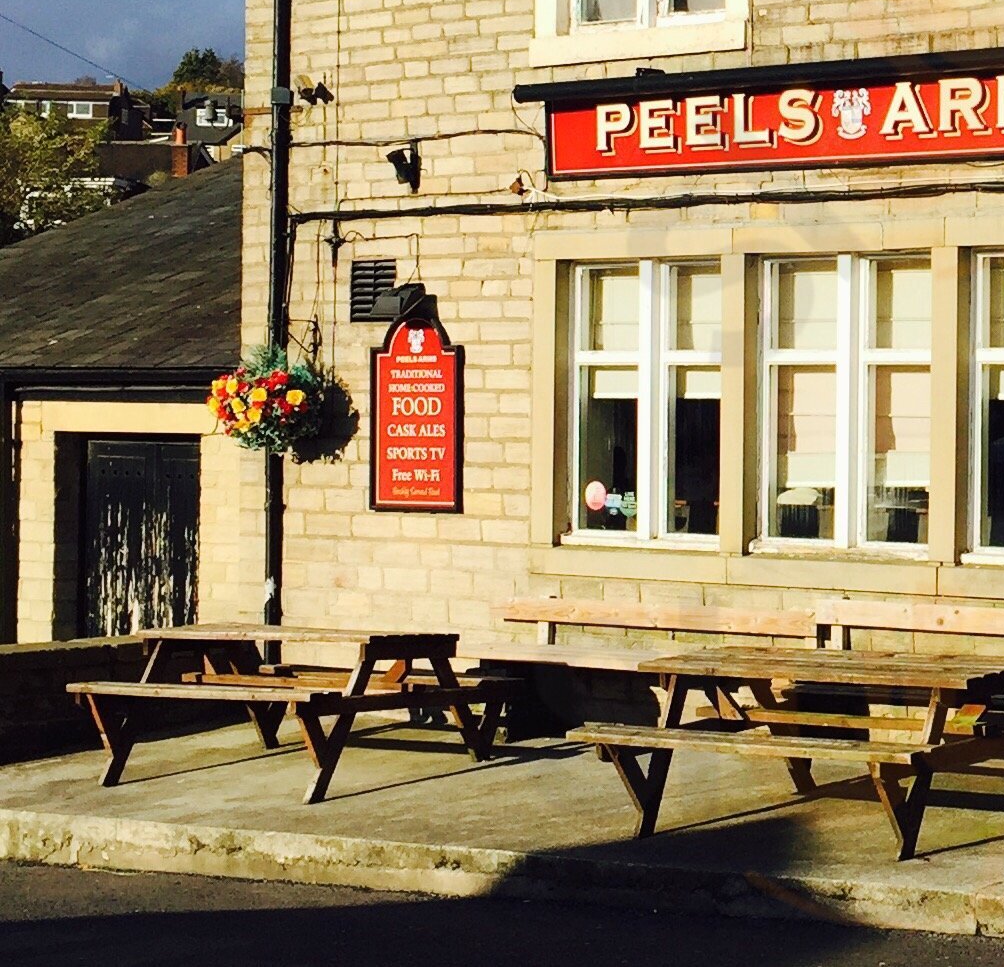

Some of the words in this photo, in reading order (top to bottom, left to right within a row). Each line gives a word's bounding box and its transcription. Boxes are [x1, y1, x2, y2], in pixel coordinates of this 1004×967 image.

[595, 88, 824, 155] PEELS
[390, 369, 443, 379] TRADITIONAL
[391, 396, 442, 417] FOOD
[387, 424, 417, 437] CASK
[418, 424, 446, 437] ALES
[386, 447, 428, 460] SPORTS
[430, 447, 446, 460] TV
[391, 468, 412, 482] Free
[413, 468, 441, 482] Wi-Fi
